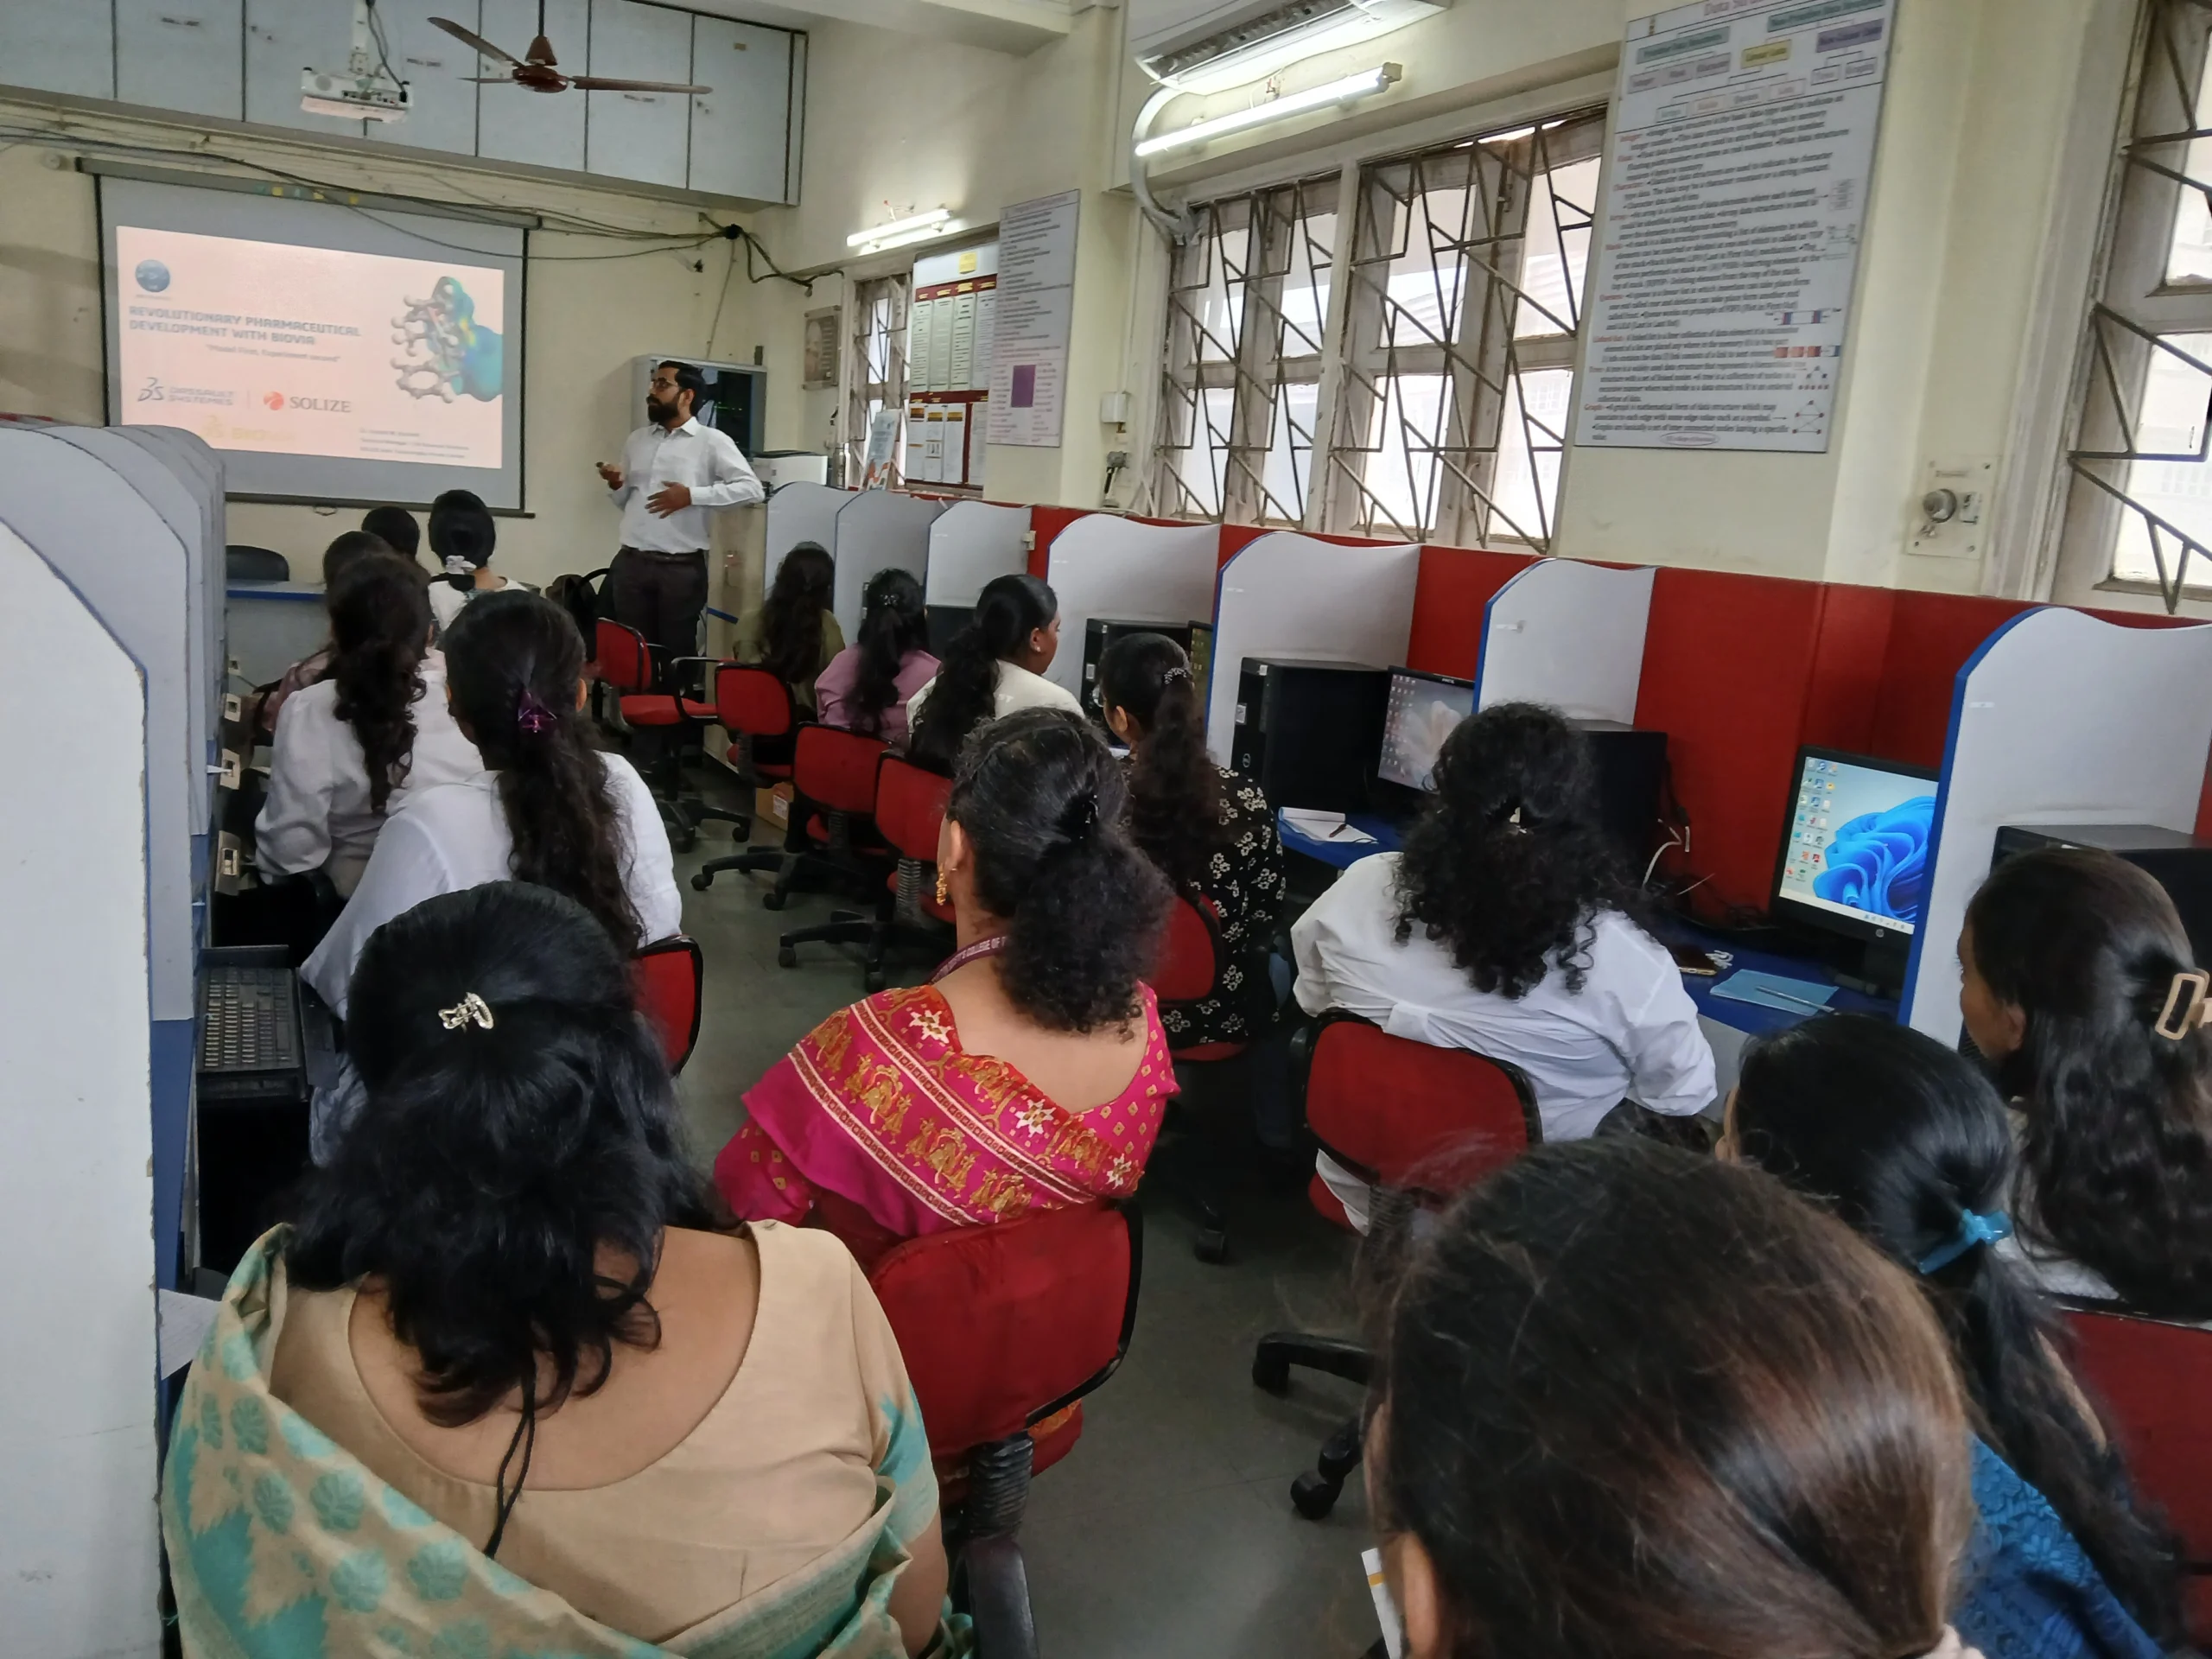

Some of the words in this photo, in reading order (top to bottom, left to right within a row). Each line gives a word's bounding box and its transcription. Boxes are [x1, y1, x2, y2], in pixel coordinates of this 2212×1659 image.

[128, 305, 242, 325] REVOLUTIONARY
[245, 316, 362, 337] PHARMACEUTICAL
[128, 319, 227, 338] DEVELOPMENT
[232, 328, 268, 341] WITH
[270, 331, 315, 346] BIOVIA
[289, 396, 353, 413] SOLIZE
